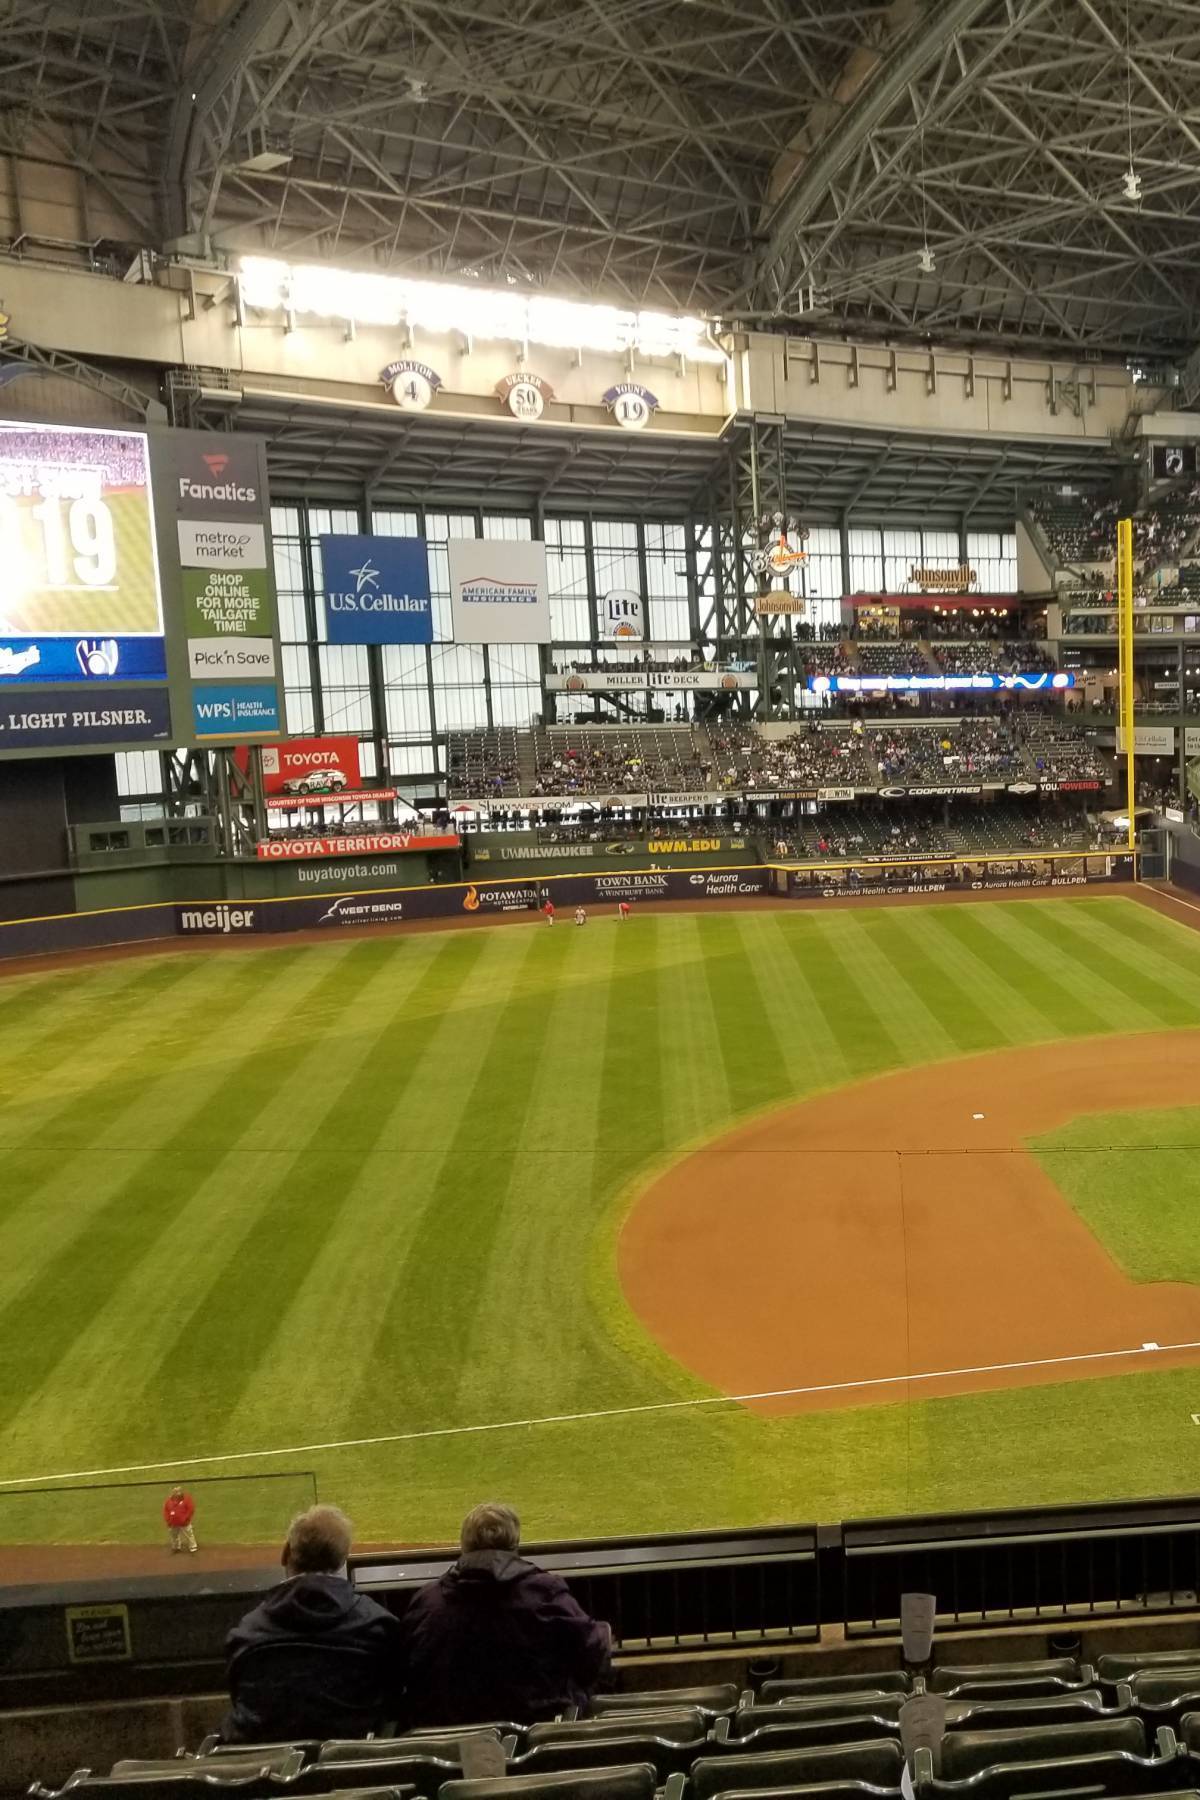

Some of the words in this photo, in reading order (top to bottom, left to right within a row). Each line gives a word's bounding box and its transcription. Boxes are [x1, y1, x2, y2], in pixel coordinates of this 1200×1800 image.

[387, 361, 433, 379] MOLITOR
[506, 373, 542, 388] UECKER
[403, 380, 419, 402] 4
[615, 384, 647, 396] YOUNT
[515, 388, 537, 406] 50
[619, 401, 645, 420] 19
[179, 478, 256, 502] Fanatics
[195, 532, 238, 545] metro
[196, 546, 245, 558] market
[209, 573, 244, 586] SHOP
[908, 563, 977, 584] Johnsonville
[204, 585, 250, 598] ONLINE
[461, 586, 505, 596] AMERICAN
[507, 587, 537, 596] FAMILY
[196, 596, 221, 609] FOR
[224, 597, 260, 610] MORE
[329, 592, 359, 612] U.S.
[360, 592, 428, 612] Cellular
[467, 595, 533, 603] INSURANCE
[608, 599, 639, 620] Lite
[757, 600, 804, 613] Johnsonville
[201, 608, 257, 621] TAILGATE
[213, 620, 247, 633] TIME!
[237, 651, 270, 665] Save
[606, 676, 644, 684] MILLER
[673, 675, 700, 685] DECK
[197, 703, 231, 719] WPS
[236, 701, 263, 710] HEALTH
[9, 712, 67, 730] LIGHT
[72, 708, 152, 727] PILSNER.
[237, 708, 276, 717] INSURANCE
[284, 751, 340, 766] TOYOTA
[309, 778, 332, 789] RAV4
[269, 798, 298, 807] COURTESY
[321, 795, 352, 803] WISCONSIN
[352, 793, 372, 801] TOYOTA
[372, 791, 395, 799] DEALERS
[261, 841, 325, 857] TOYOTA
[327, 835, 411, 852] TERRITORY
[648, 839, 721, 853] UWM.EDU
[298, 863, 398, 882] buyatoyota.com
[707, 873, 739, 883] Aurora
[595, 876, 632, 888] TOWN
[634, 875, 669, 886] BANK
[984, 880, 1007, 889] Aurora
[1008, 879, 1030, 888] Health
[1031, 878, 1048, 887] Care
[1051, 877, 1087, 886] BULLPEN
[605, 889, 643, 897] WINTRUST
[645, 887, 665, 895] BANK
[706, 884, 737, 895] Health
[738, 883, 760, 893] Care
[836, 888, 861, 897] Aurora
[862, 887, 886, 896] Health
[887, 886, 903, 894] Care
[907, 884, 945, 893] BULLPEN
[339, 905, 371, 916] WEST
[371, 903, 402, 913] BEND
[181, 904, 255, 933] meijer
